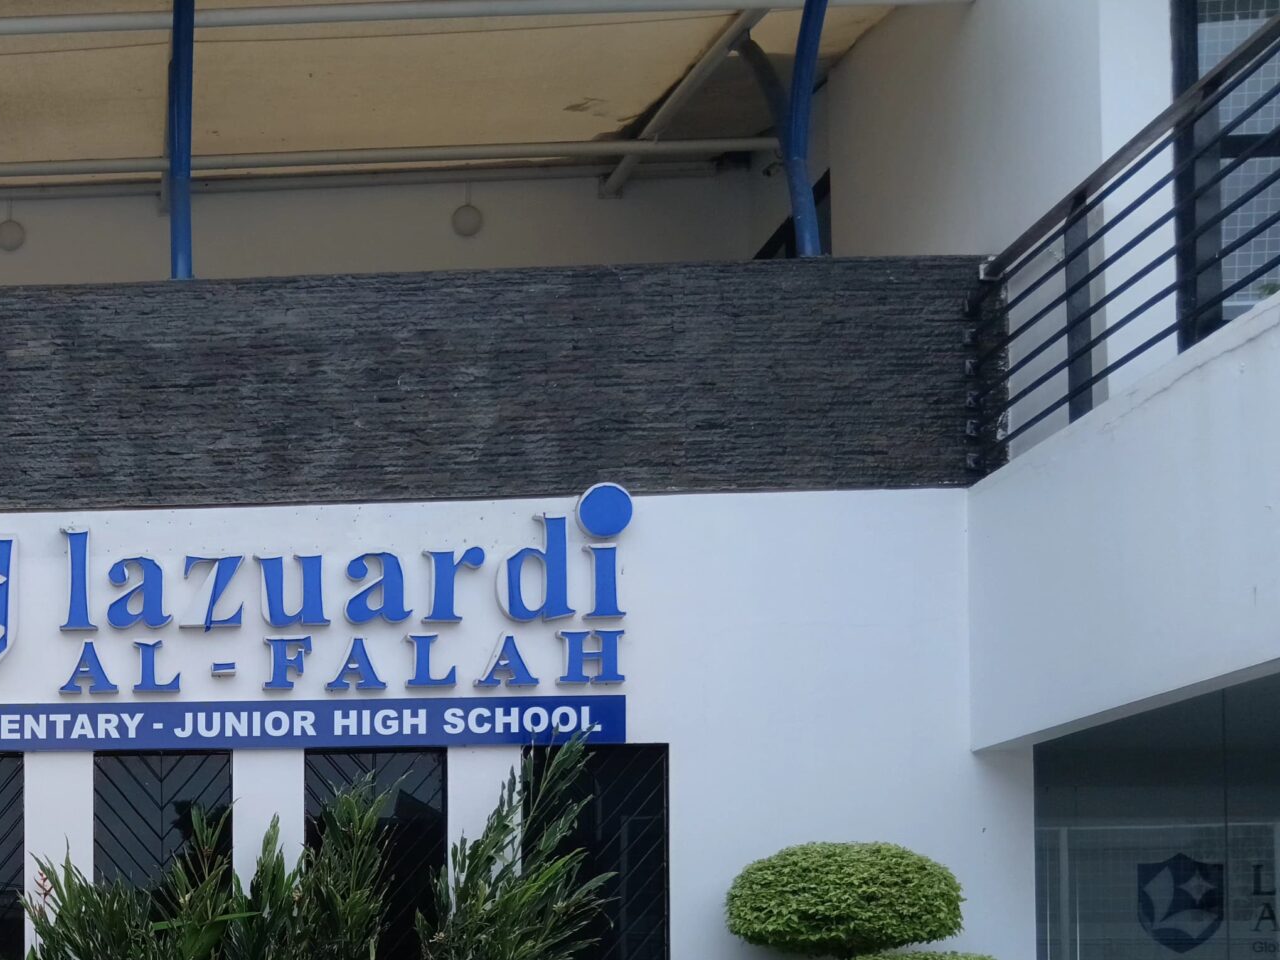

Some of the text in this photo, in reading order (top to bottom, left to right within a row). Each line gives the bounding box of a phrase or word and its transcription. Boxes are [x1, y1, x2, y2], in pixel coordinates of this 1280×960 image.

[60, 482, 633, 633] lazuardi
[173, 710, 317, 738] JUNIOR
[333, 708, 427, 736] HIGH
[443, 705, 602, 735] SCHOOL
